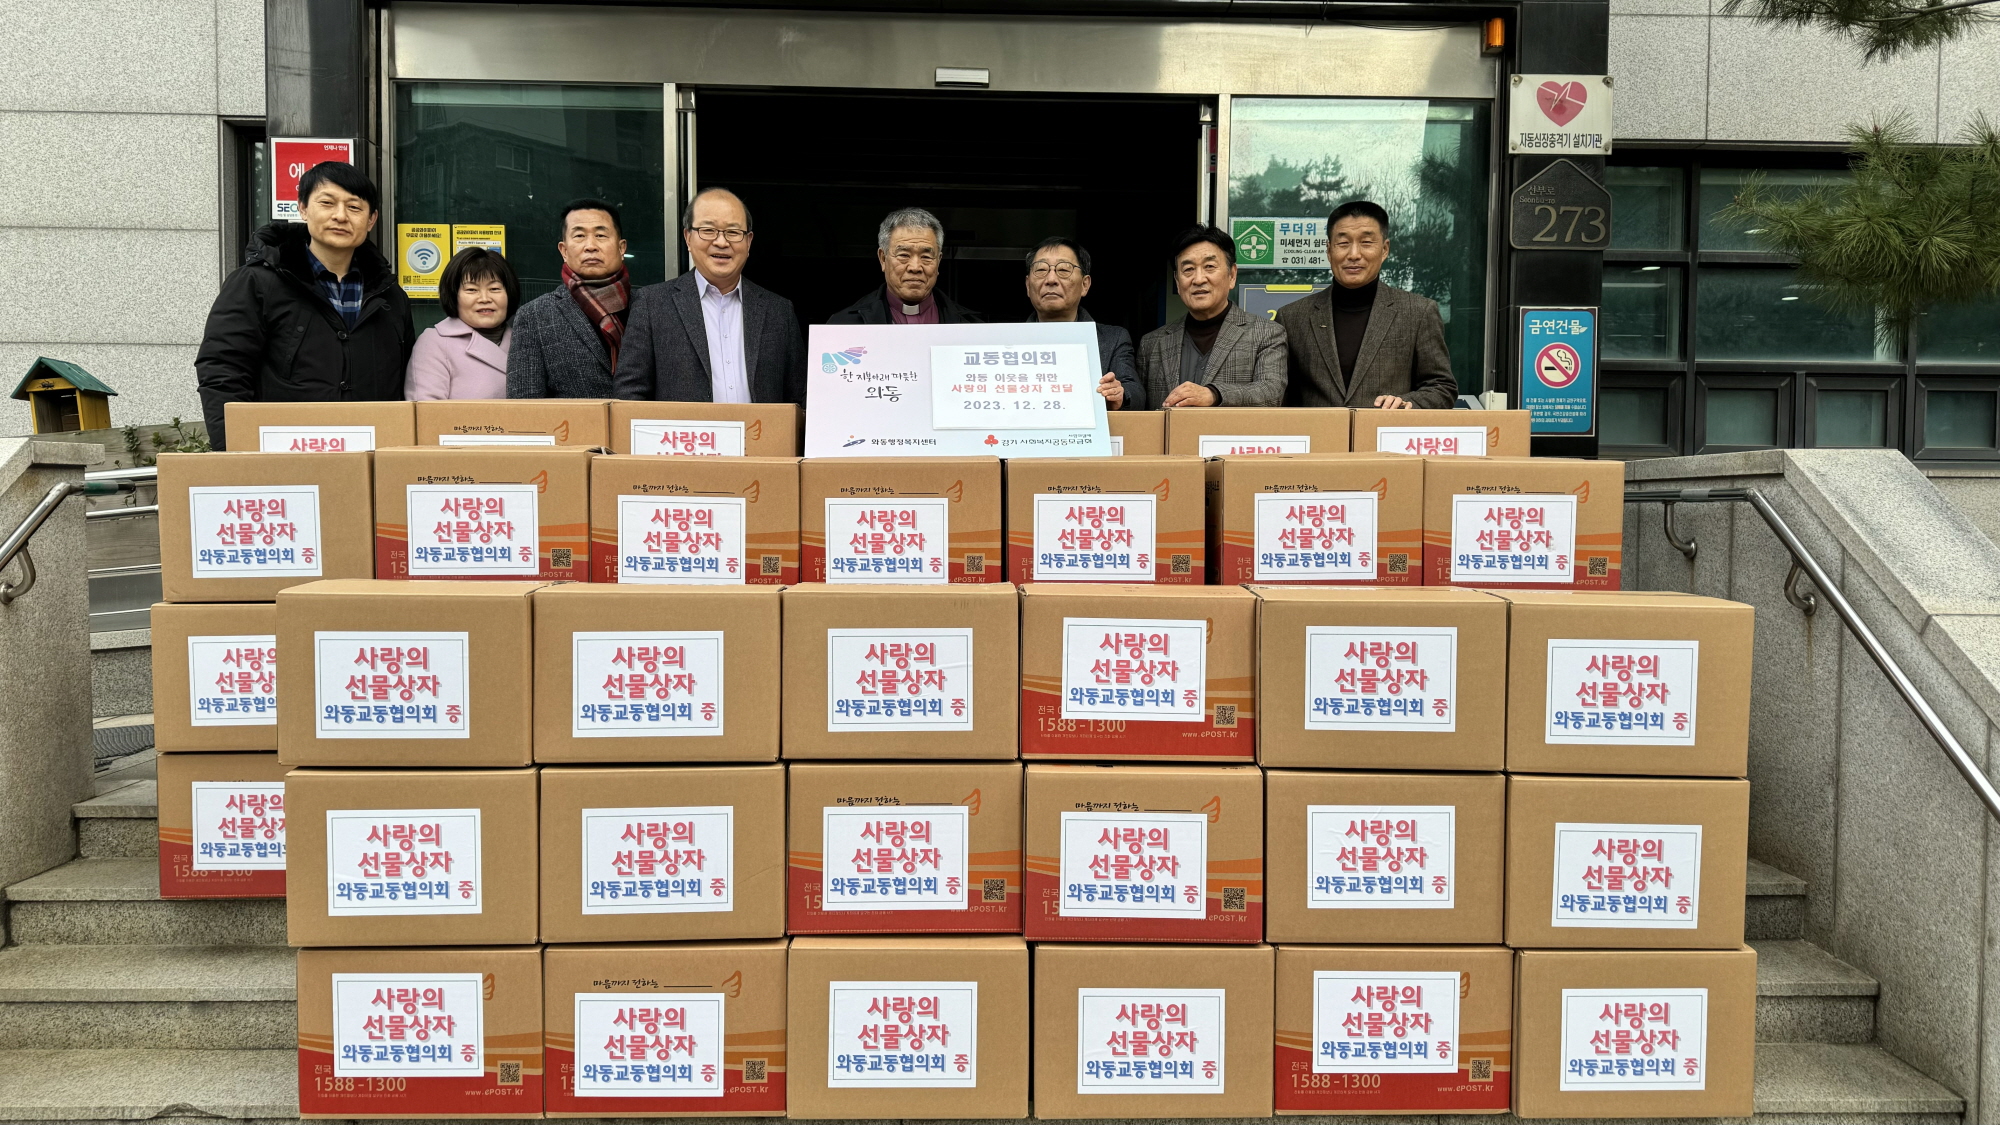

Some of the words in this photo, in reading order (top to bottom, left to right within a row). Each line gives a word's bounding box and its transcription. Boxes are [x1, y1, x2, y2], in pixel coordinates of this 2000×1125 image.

[1519, 133, 1571, 148] 자동심장충격기
[1572, 133, 1602, 149] 설치기관
[1528, 184, 1556, 196] 선부로
[1279, 222, 1317, 236] 무더위
[1532, 205, 1607, 243] 273
[1280, 238, 1311, 248] 미세먼지
[1313, 238, 1329, 248] 쉼터
[1291, 255, 1307, 265] 031)
[1529, 319, 1582, 335] 금연건물
[963, 351, 1057, 366] 교동협의회
[840, 368, 853, 383] 한
[856, 371, 890, 382] 지붕아래
[891, 370, 918, 382] 따뜻한
[965, 373, 988, 383] 와동
[994, 373, 1029, 383] 이웃을
[1035, 373, 1058, 383] 위한
[864, 385, 903, 403] 와동
[951, 384, 987, 393] 사랑의
[994, 384, 1043, 394] 선물상자
[1050, 383, 1073, 393] 전달
[963, 400, 1006, 410] 2023.
[1013, 400, 1036, 410] 12.
[1043, 400, 1066, 410] 28.
[660, 431, 715, 453] 사랑의
[871, 438, 937, 446] 와동행정복지센터
[1001, 439, 1018, 447] 경기
[1020, 438, 1092, 446] 사회복지공동모금회
[1405, 437, 1458, 455] 사랑의
[223, 499, 285, 523] 사랑의
[441, 497, 503, 521] 사랑의
[651, 508, 712, 532] 사랑의
[1065, 506, 1124, 529] 사랑의
[1285, 505, 1346, 528] 사랑의
[1484, 507, 1544, 530] 사랑의
[433, 521, 514, 543] 선물상자
[857, 510, 916, 533] 사랑의
[217, 522, 296, 545] 선물상자
[643, 531, 722, 554] 선물상자
[849, 533, 925, 555] 선물상자
[1057, 529, 1133, 551] 선물상자
[1278, 527, 1355, 550] 선물상자
[1476, 530, 1552, 552] 선물상자
[200, 548, 294, 565] 와동교동협의회
[303, 547, 313, 563] 증
[416, 546, 511, 563] 와동교동협의회
[519, 546, 531, 562] 증
[626, 556, 719, 572] 와동교동협의회
[726, 557, 738, 573] 증
[833, 557, 923, 573] 와동교동협의회
[929, 557, 942, 573] 증
[1039, 553, 1130, 569] 와동교동협의회
[1137, 553, 1149, 569] 증
[1261, 552, 1351, 568] 와동교동협의회
[1359, 551, 1369, 567] 증
[1457, 554, 1548, 570] 와동교동협의회
[1557, 555, 1566, 570] 증
[865, 642, 935, 670] 사랑의
[1099, 632, 1169, 660] 사랑의
[1344, 641, 1417, 669] 사랑의
[354, 647, 428, 675] 사랑의
[611, 646, 684, 674] 사랑의
[1586, 655, 1658, 682] 사랑의
[215, 671, 276, 694] 선물상
[856, 669, 946, 695] 선물상자
[1090, 659, 1179, 685] 선물상자
[1334, 668, 1428, 695] 선물상자
[345, 675, 440, 701] 선물상자
[602, 673, 696, 700] 선물상자
[1069, 687, 1175, 707] 와동교동협의회
[1183, 689, 1197, 707] 증
[1576, 682, 1669, 708] 선물상자
[197, 697, 277, 713] 와동교동협의
[324, 704, 437, 724] 와동교동협의회
[446, 705, 461, 723] 증
[581, 703, 692, 722] 와동교동협의회
[701, 702, 715, 721] 증
[835, 698, 942, 717] 와동교동협의회
[951, 698, 965, 716] 증
[1312, 697, 1423, 716] 와동교동협의회
[1433, 698, 1448, 717] 증
[1553, 711, 1664, 730] 와동교동협의회
[1674, 712, 1687, 730] 증
[1181, 730, 1239, 739] www.ePOST.kr
[367, 823, 440, 852] 사랑의
[620, 821, 693, 850] 사랑의
[860, 820, 930, 848] 사랑의
[1097, 827, 1168, 855] 사랑의
[1345, 819, 1416, 846] 사랑의
[611, 849, 705, 876] 선물상자
[851, 847, 941, 874] 선물상자
[1336, 846, 1427, 872] 선물상자
[1592, 838, 1663, 866] 사랑의
[358, 851, 453, 878] 선물상자
[1088, 854, 1179, 881] 선물상자
[590, 878, 701, 899] 와동교동협의회
[710, 878, 725, 896] 증
[831, 877, 937, 896] 와동교동협의회
[946, 876, 960, 895] 증
[1315, 876, 1423, 894] 와동교동협의회
[1432, 876, 1446, 894] 증
[1582, 865, 1673, 892] 선물상자
[337, 881, 449, 901] 와동교동협의회
[459, 880, 473, 899] 증
[1068, 883, 1175, 903] 와동교동협의회
[1184, 885, 1198, 904] 증
[1560, 894, 1667, 913] 와동교동협의회
[1676, 896, 1691, 914] 증
[371, 987, 443, 1015] 사랑의
[1351, 985, 1421, 1012] 사랑의
[613, 1007, 685, 1035] 사랑의
[867, 996, 938, 1024] 사랑의
[1115, 1003, 1186, 1031] 사랑의
[1599, 1002, 1669, 1029] 사랑의
[363, 1015, 455, 1041] 선물상자
[1341, 1012, 1432, 1038] 선물상자
[604, 1034, 696, 1061] 선물상자
[857, 1024, 949, 1051] 선물상자
[1106, 1030, 1197, 1057] 선물상자
[1590, 1029, 1679, 1055] 선물상자
[342, 1044, 452, 1063] 와동교동협의회
[461, 1044, 475, 1062] 증
[1320, 1041, 1428, 1059] 와동교동협의회
[1437, 1041, 1450, 1059] 증
[582, 1064, 692, 1083] 와동교동협의회
[701, 1064, 716, 1083] 증
[836, 1054, 945, 1073] 와동교동협의회
[954, 1054, 969, 1072] 증
[1086, 1060, 1193, 1079] 와동교동협의회
[1202, 1060, 1217, 1079] 증
[1569, 1058, 1675, 1077] 와동교동협의회
[1684, 1058, 1697, 1075] 증
[314, 1076, 407, 1092] 1588-1300
[465, 1087, 524, 1096] www.ePOST.kr
[1291, 1073, 1381, 1089] 1588-1300
[1437, 1084, 1494, 1092] www.ePOST.kr
